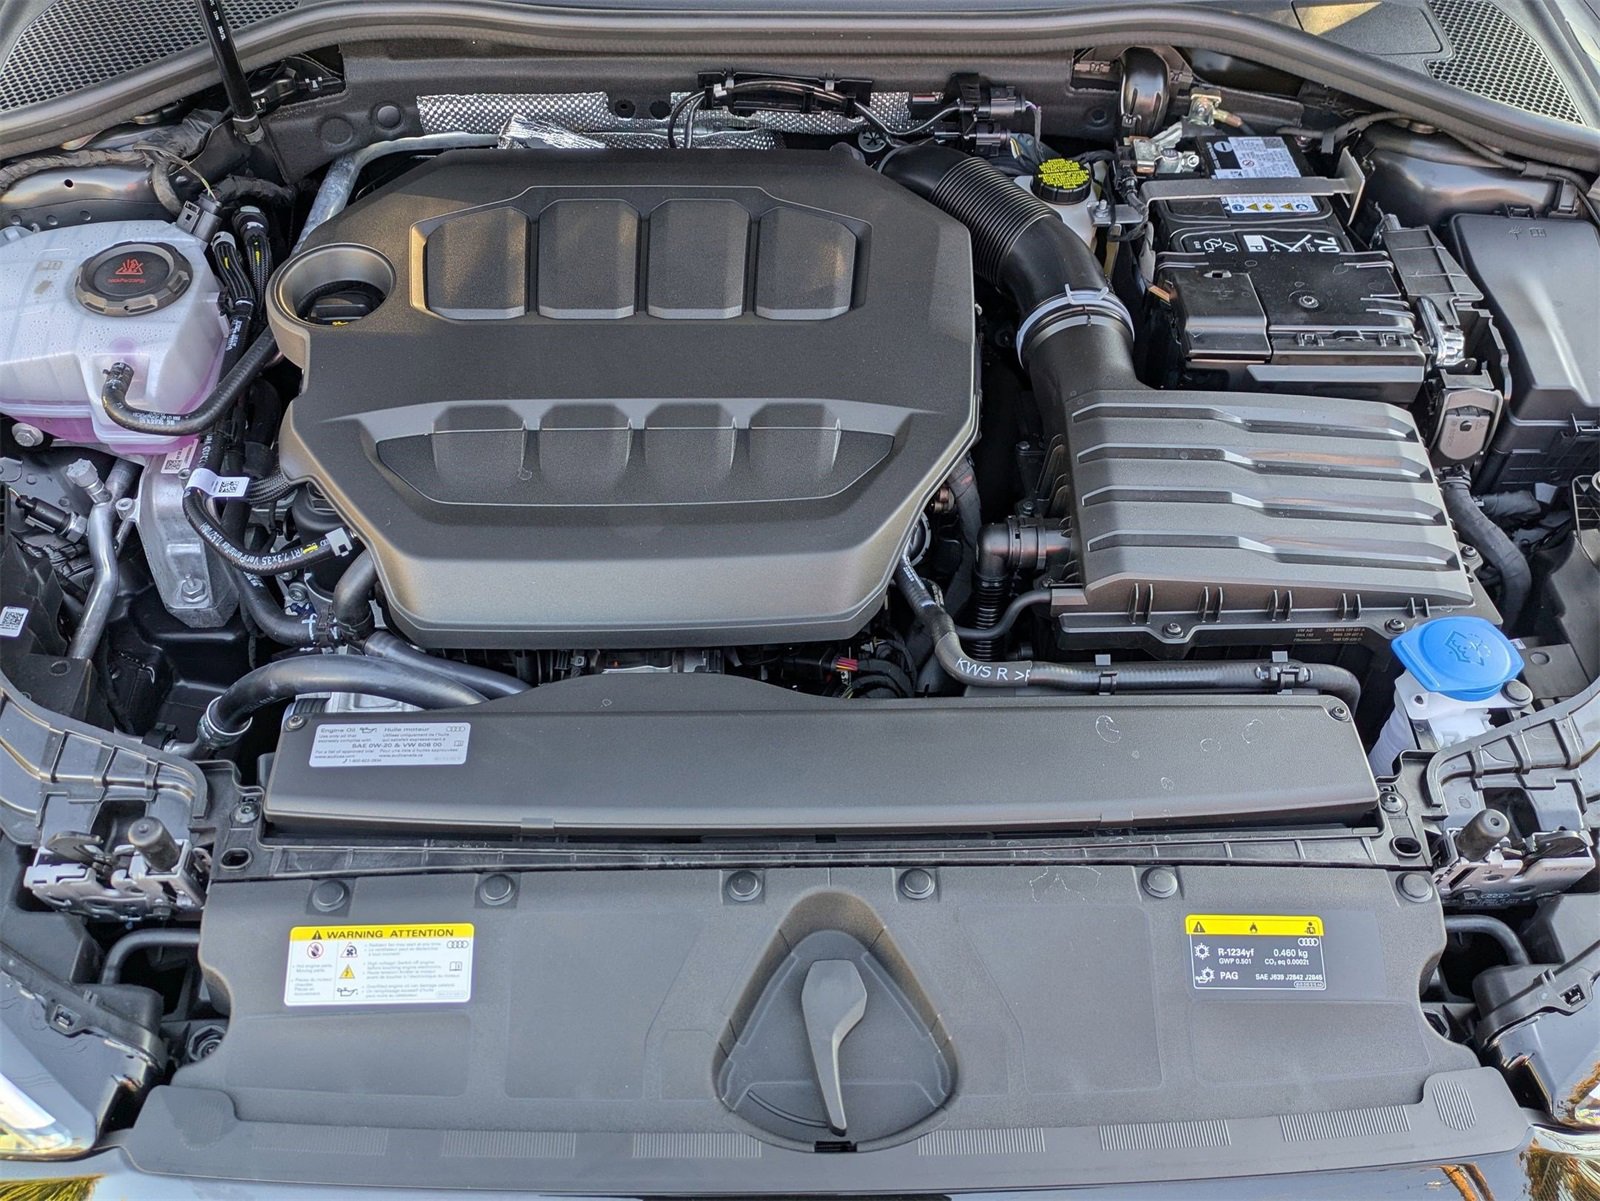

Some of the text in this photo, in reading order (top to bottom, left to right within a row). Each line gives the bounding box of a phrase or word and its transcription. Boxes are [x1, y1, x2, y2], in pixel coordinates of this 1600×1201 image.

[1314, 237, 1340, 252] 70
[955, 657, 992, 678] KWS
[996, 667, 1008, 681] R
[327, 929, 454, 939] WARNING ATTENTION
[1218, 948, 1309, 958] R-1234yf 0.460 kg
[1220, 971, 1239, 980] PAG
